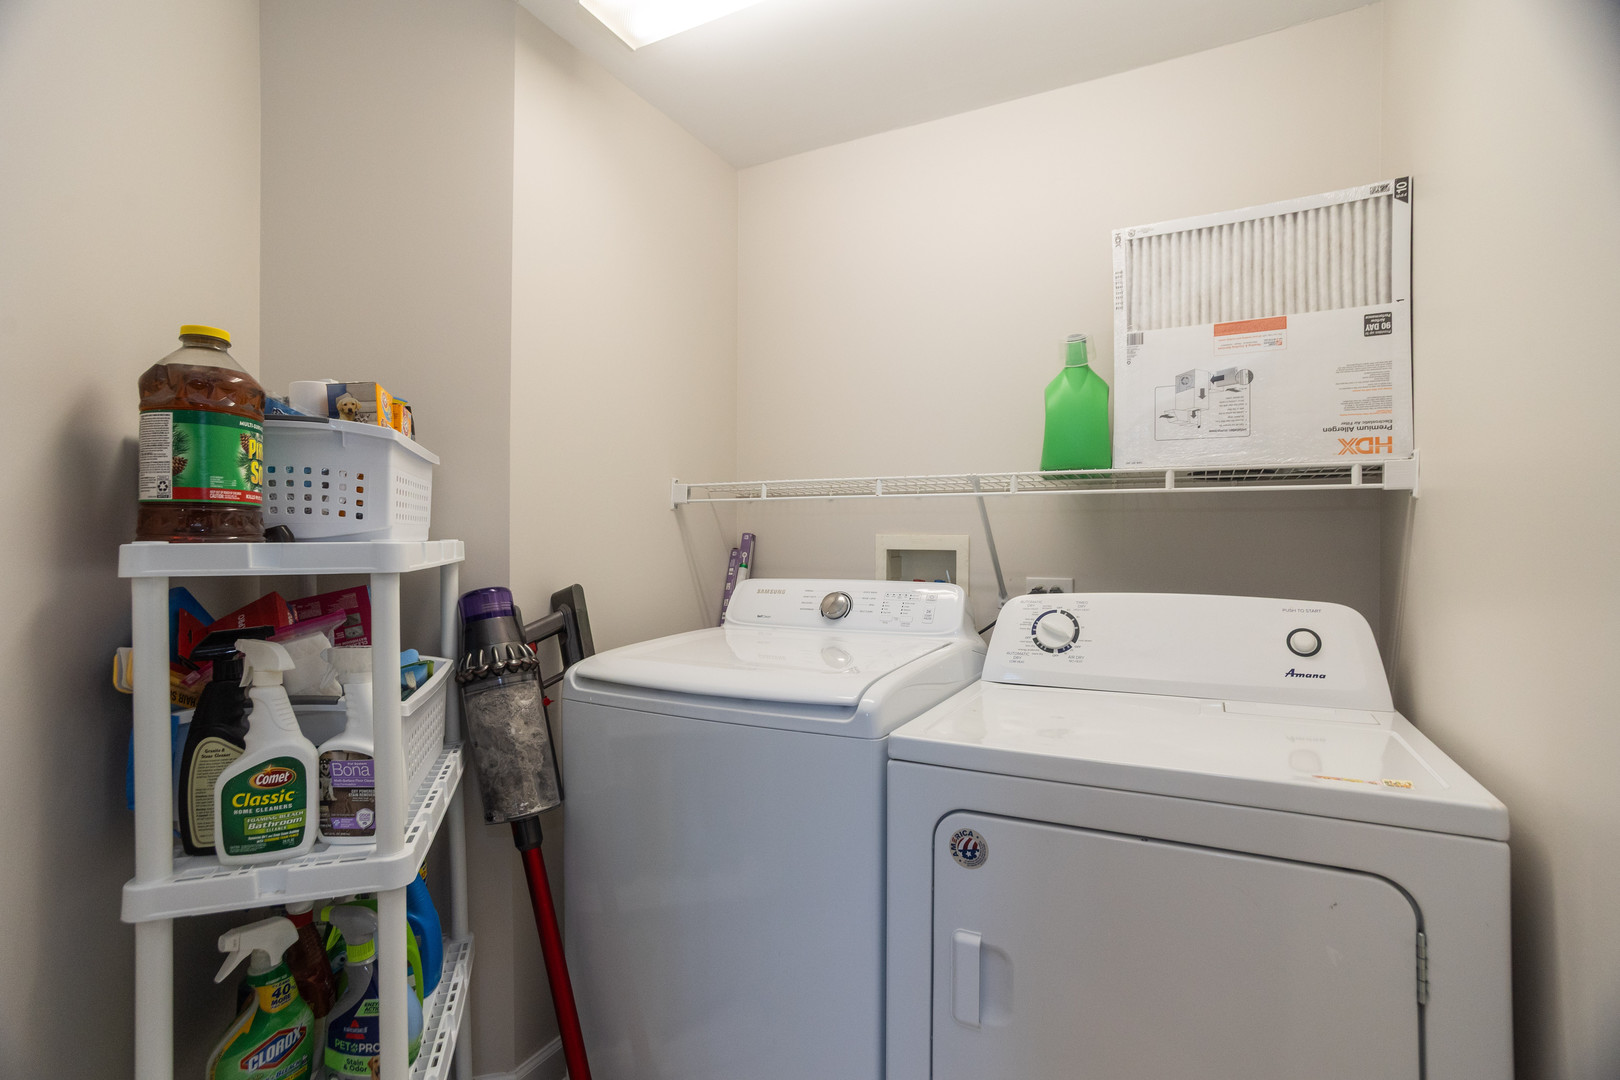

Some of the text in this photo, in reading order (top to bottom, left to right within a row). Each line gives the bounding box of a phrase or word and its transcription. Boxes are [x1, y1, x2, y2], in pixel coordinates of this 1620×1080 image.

[1396, 181, 1408, 193] 10
[1365, 322, 1391, 331] 90 DAY
[1356, 424, 1393, 432] Premium
[1338, 436, 1393, 456] HDX
[1284, 668, 1327, 680] Amana
[179, 693, 197, 706] HAIR
[332, 762, 370, 777] Bona
[255, 771, 290, 786] Comet
[232, 789, 295, 808] Classic
[256, 803, 293, 813] CLEANERS
[247, 810, 304, 823] FOAMING BLEACH
[248, 817, 303, 831] Bathroom
[266, 825, 287, 833] CLEANER
[950, 829, 974, 857] AMERICA
[247, 1025, 302, 1073] CLOROX
[334, 1037, 351, 1052] PET
[346, 1058, 364, 1066] Stain
